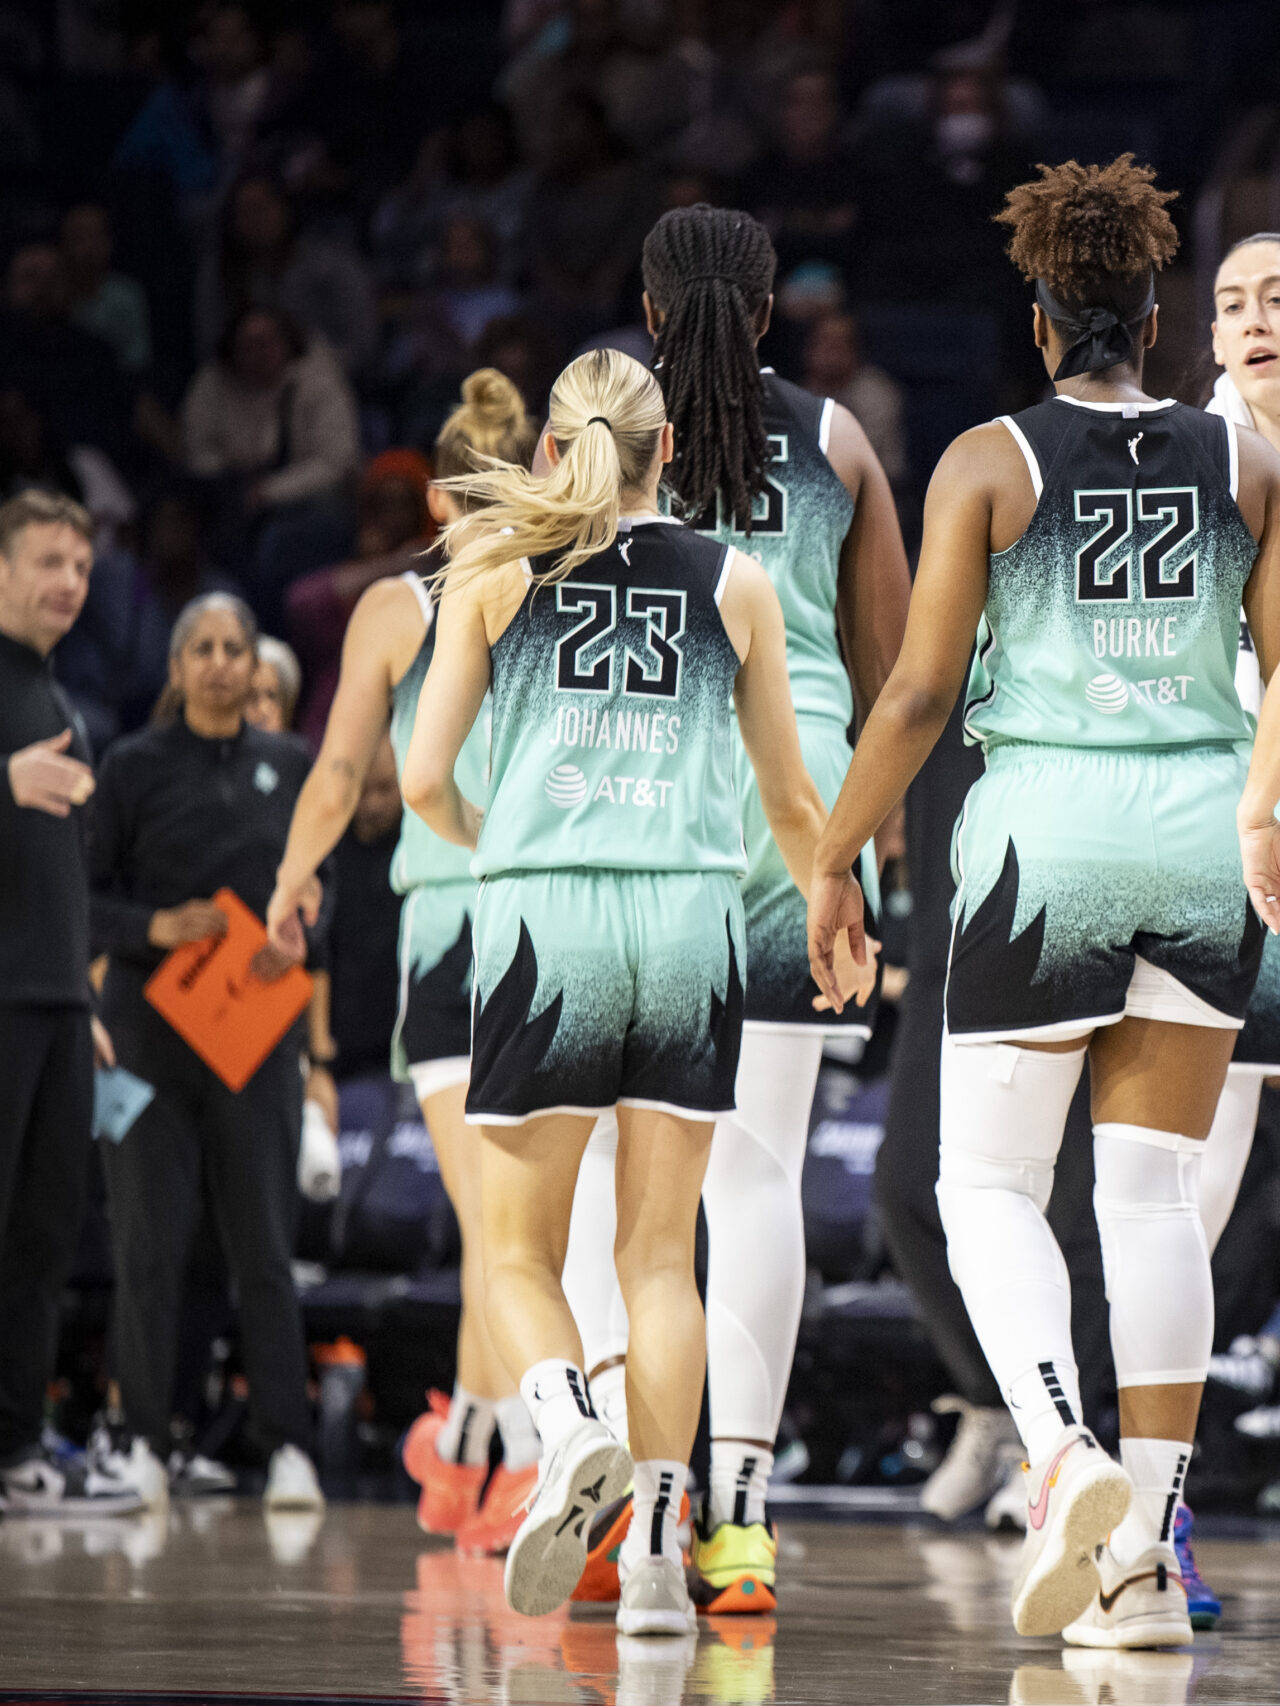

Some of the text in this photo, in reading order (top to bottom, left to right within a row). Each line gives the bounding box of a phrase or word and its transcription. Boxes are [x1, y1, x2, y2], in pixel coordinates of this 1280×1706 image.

[1074, 487, 1199, 603] 22
[555, 582, 687, 700] 23
[1093, 617, 1178, 658] BURKE
[1129, 675, 1195, 705] AT&T
[549, 706, 681, 755] JOHANNÈS
[593, 775, 674, 808] AT&T
